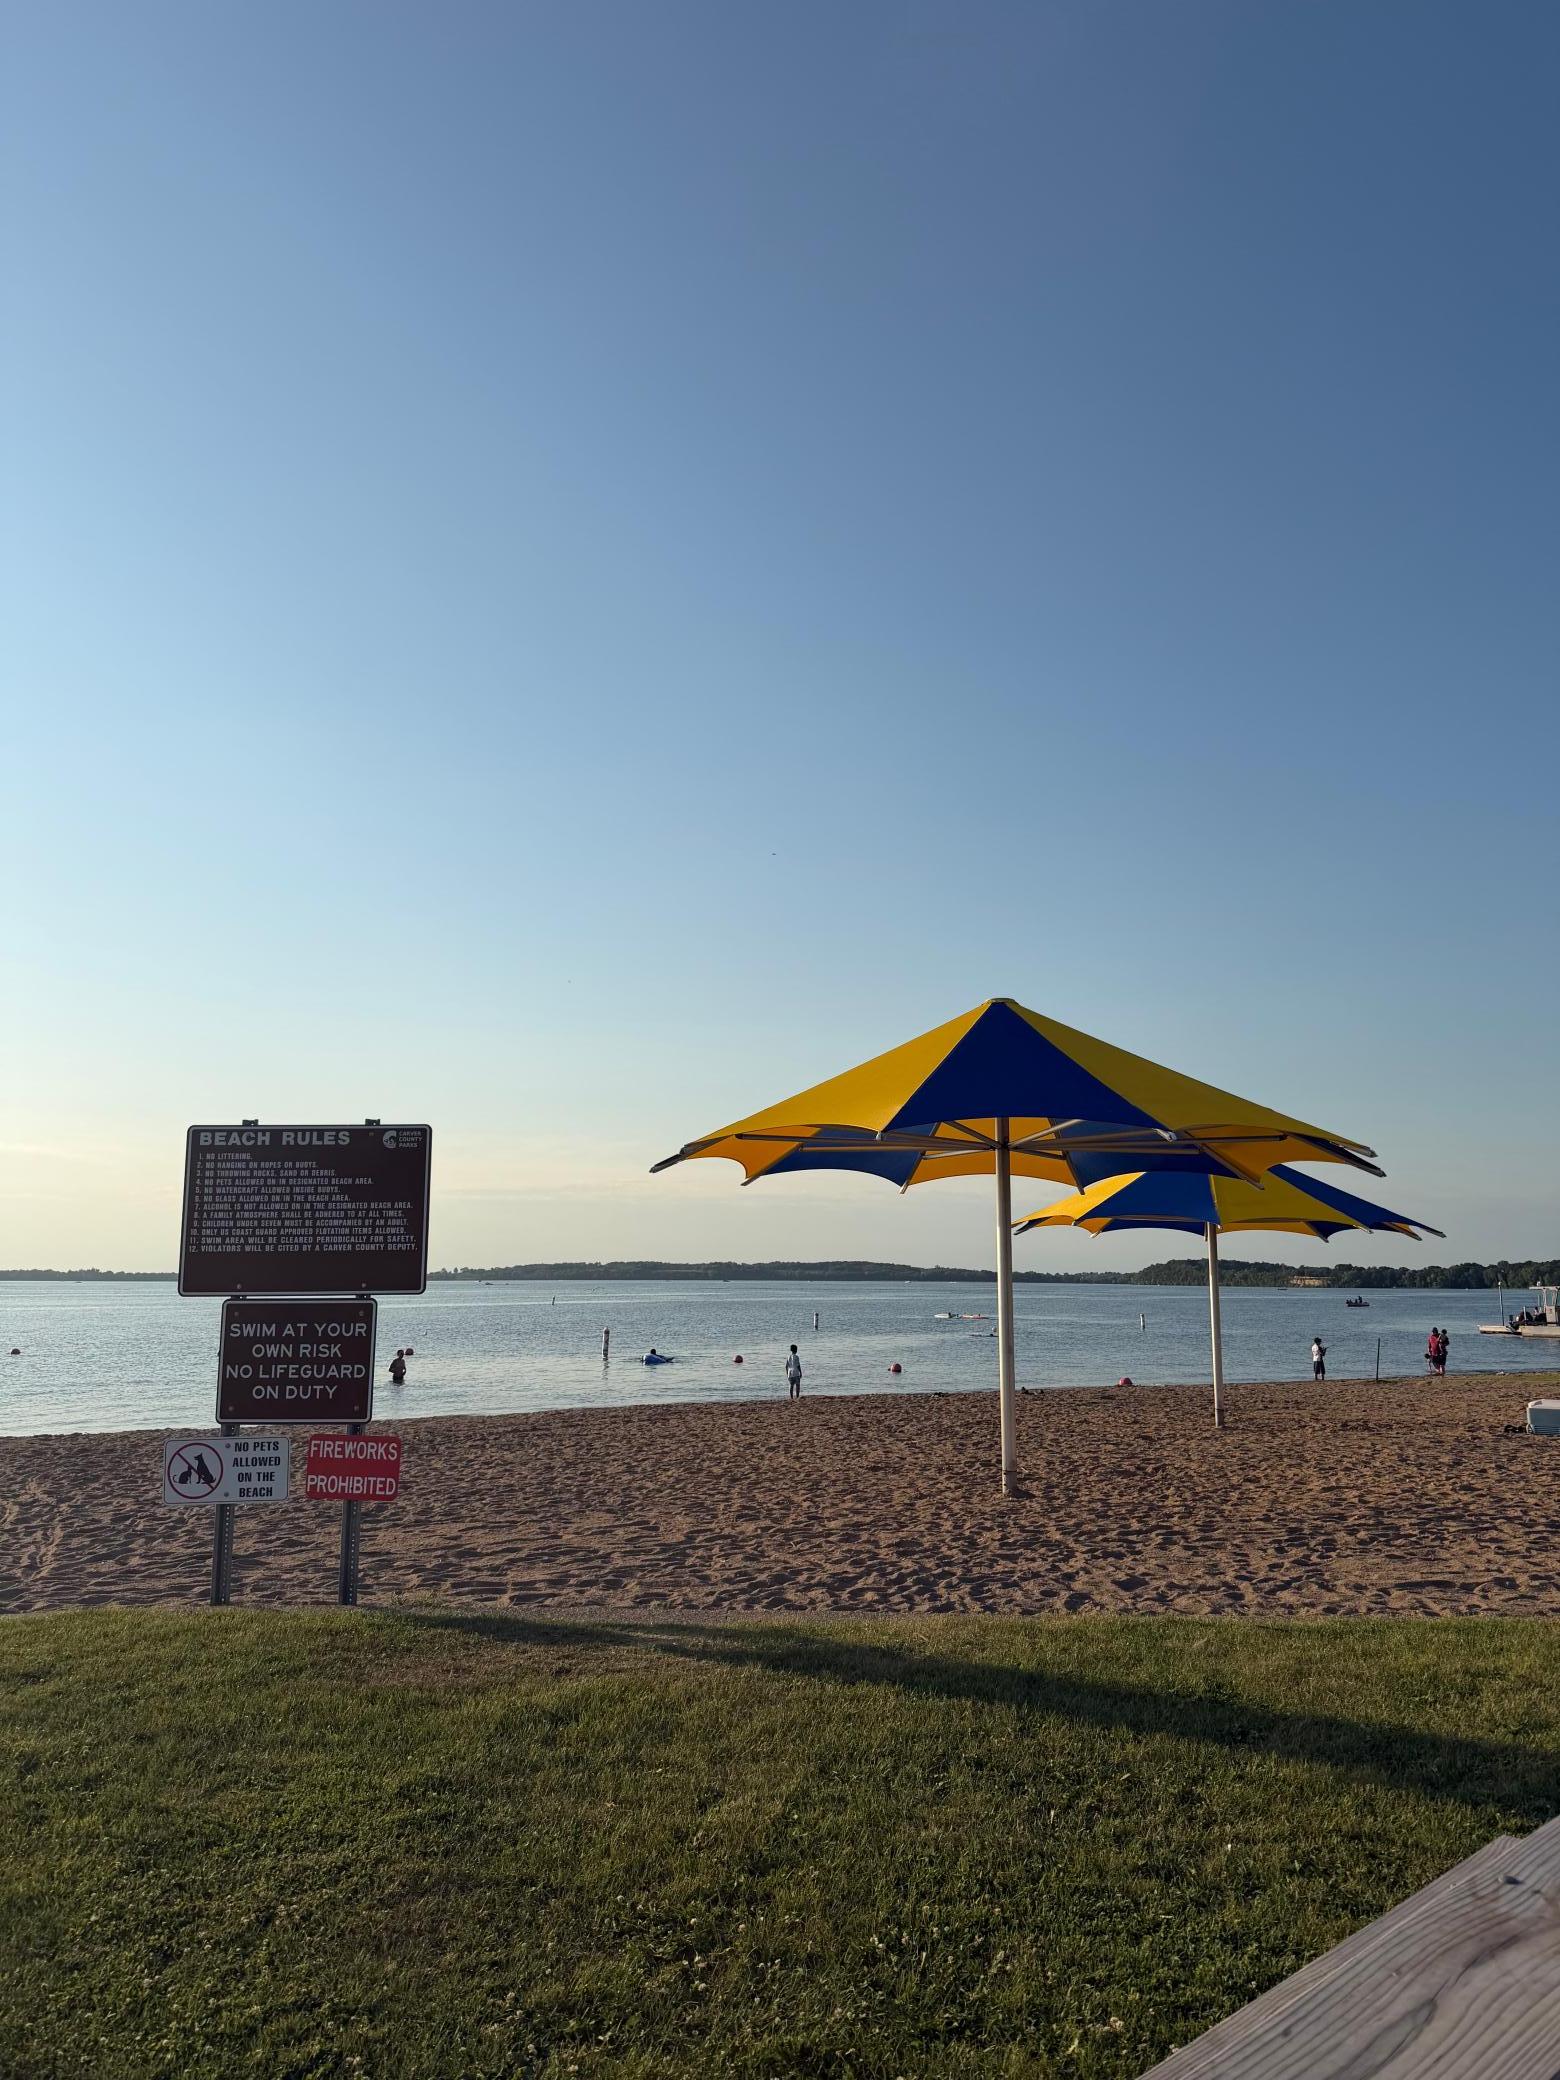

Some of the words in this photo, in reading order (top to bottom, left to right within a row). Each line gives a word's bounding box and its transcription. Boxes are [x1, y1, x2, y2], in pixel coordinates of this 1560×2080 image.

[200, 1132, 270, 1146] BEACH
[282, 1131, 350, 1145] RULES
[230, 1323, 276, 1337] SWIM
[282, 1323, 307, 1336] AT
[314, 1323, 366, 1336] YOUR
[252, 1344, 292, 1357] OWN
[300, 1344, 342, 1357] RISK
[226, 1365, 252, 1378] NO
[259, 1365, 366, 1378] LIFEGUARD
[252, 1386, 279, 1399] ON
[286, 1386, 338, 1399] DUTY
[234, 1442, 249, 1452] NO
[254, 1441, 279, 1451] PETS
[310, 1441, 398, 1460] FIREWORKS
[232, 1456, 280, 1467] ALLOWED
[237, 1472, 252, 1482] ON
[257, 1471, 275, 1482] THE
[306, 1475, 396, 1495] PROHIBITED
[239, 1487, 273, 1498] BEACH
